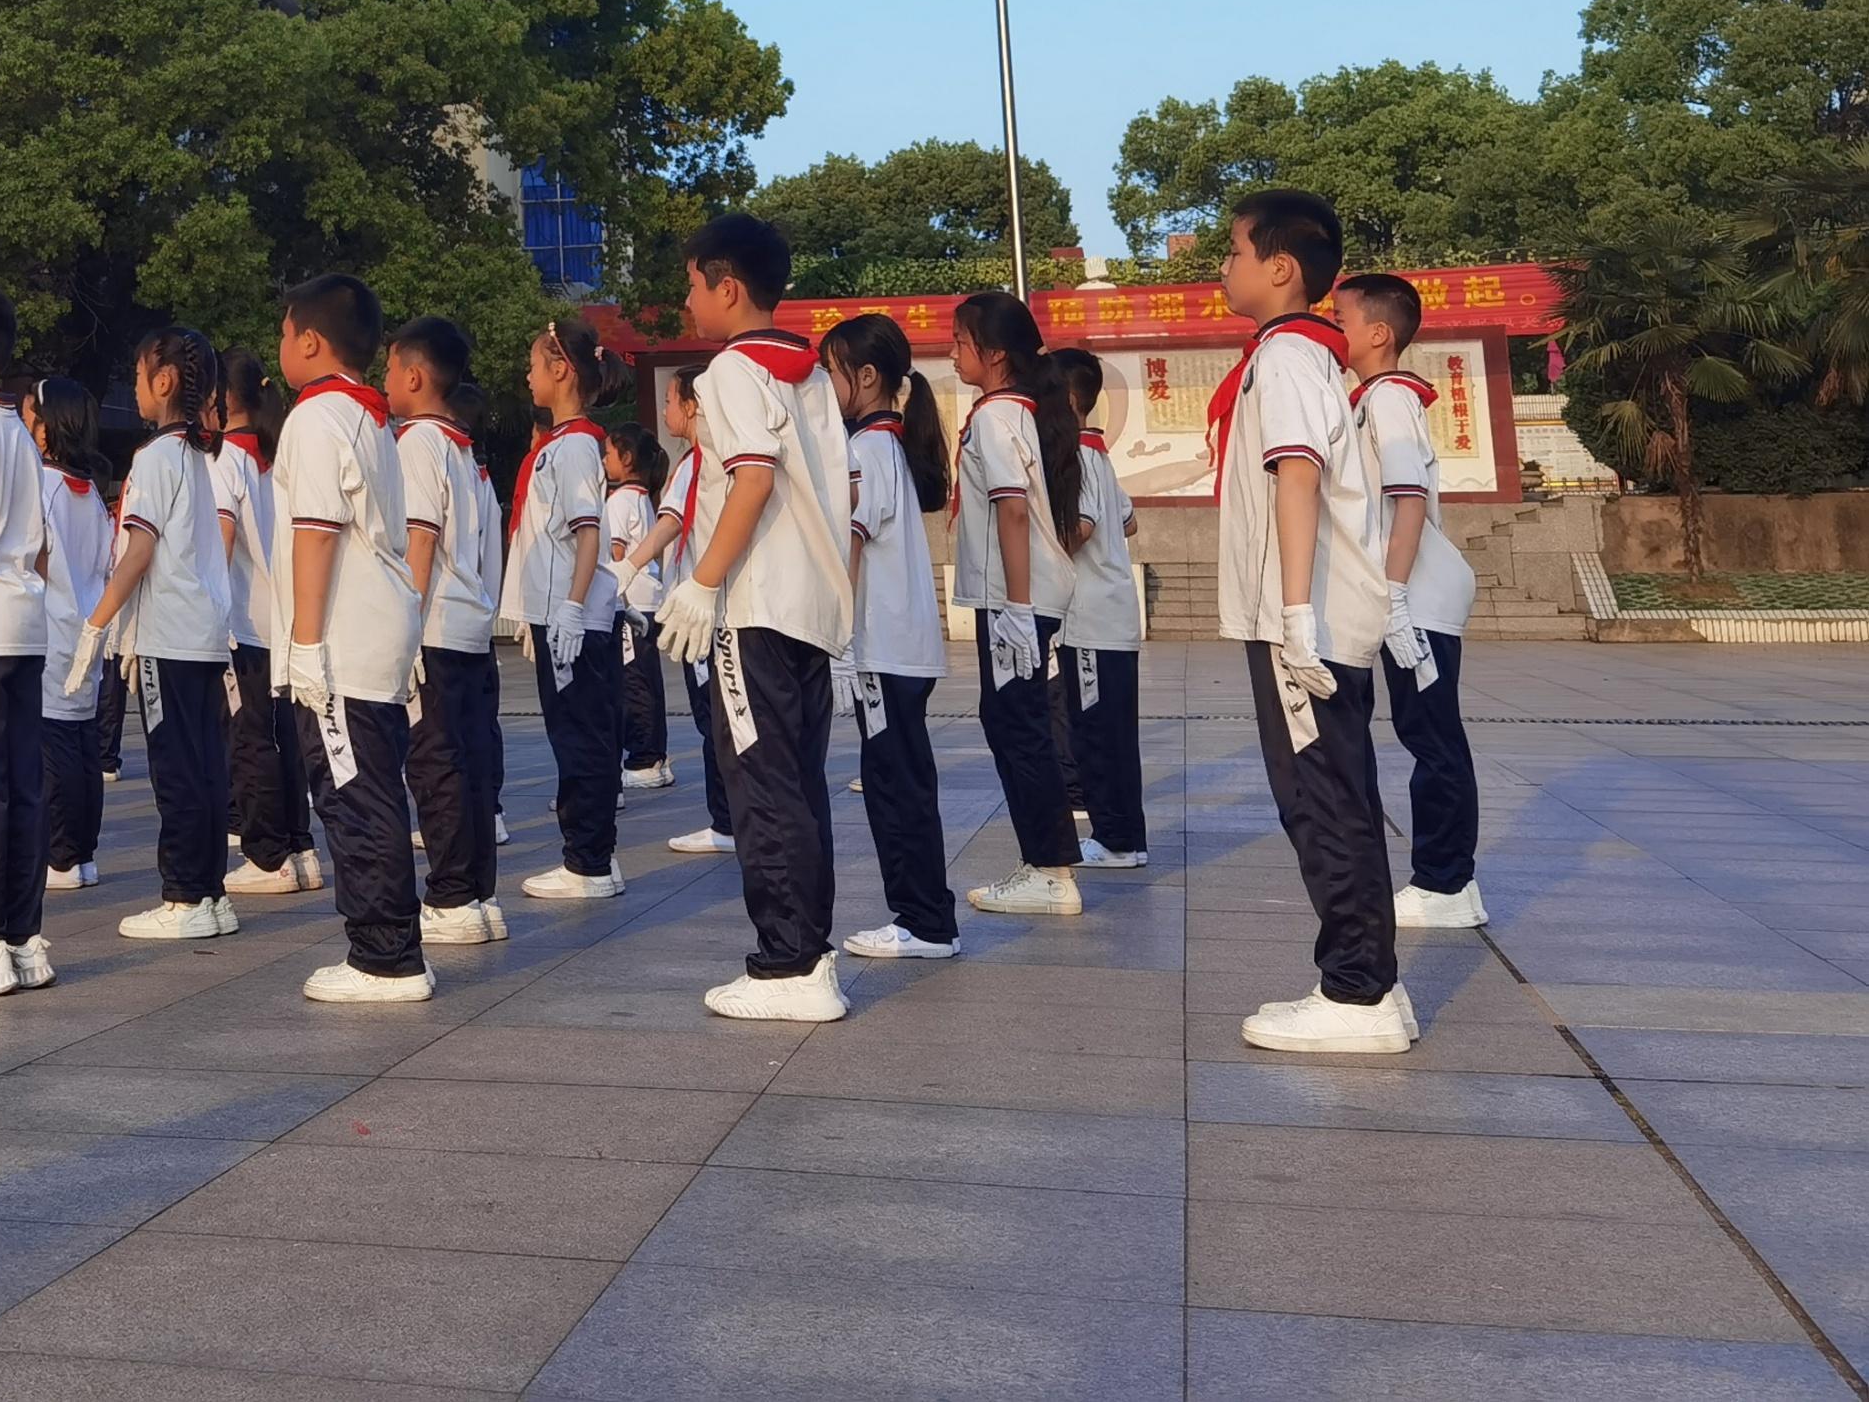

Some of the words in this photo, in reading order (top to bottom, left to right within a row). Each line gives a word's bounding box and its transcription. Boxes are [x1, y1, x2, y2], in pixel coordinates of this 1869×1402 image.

[1145, 358, 1171, 400] 博爱
[1447, 355, 1472, 450] 教育植根于爱
[717, 629, 741, 697] Sport
